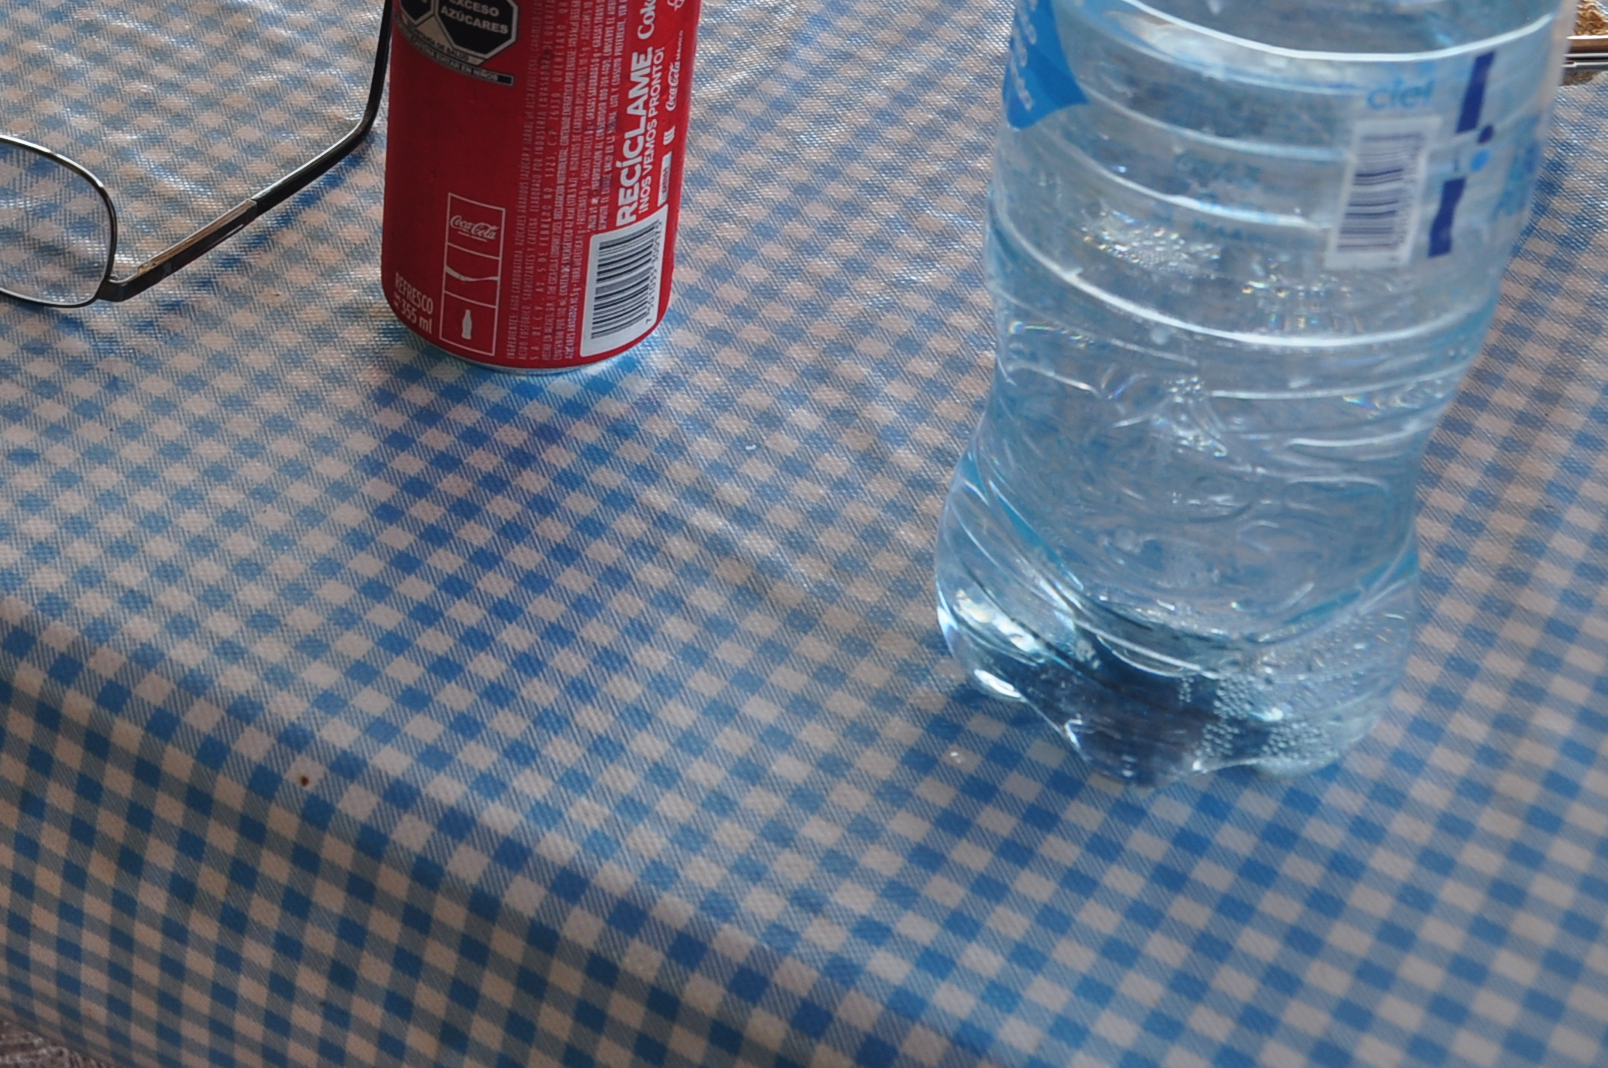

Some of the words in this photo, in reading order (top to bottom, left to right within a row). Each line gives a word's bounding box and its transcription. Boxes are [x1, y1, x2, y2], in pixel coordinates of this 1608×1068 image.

[441, 5, 509, 35] AZÚCARES
[647, 46, 664, 116] PRONTO!
[664, 60, 681, 110] Coca-Cola
[1367, 76, 1435, 110] ciel
[615, 46, 653, 226] RECÍCLAME
[642, 118, 657, 175] VEMOS
[638, 175, 652, 213] ¡NOS
[450, 215, 500, 240] Coca-Cola
[395, 271, 434, 316] REFRESCO
[400, 298, 417, 325] 355
[419, 316, 433, 335] ml
